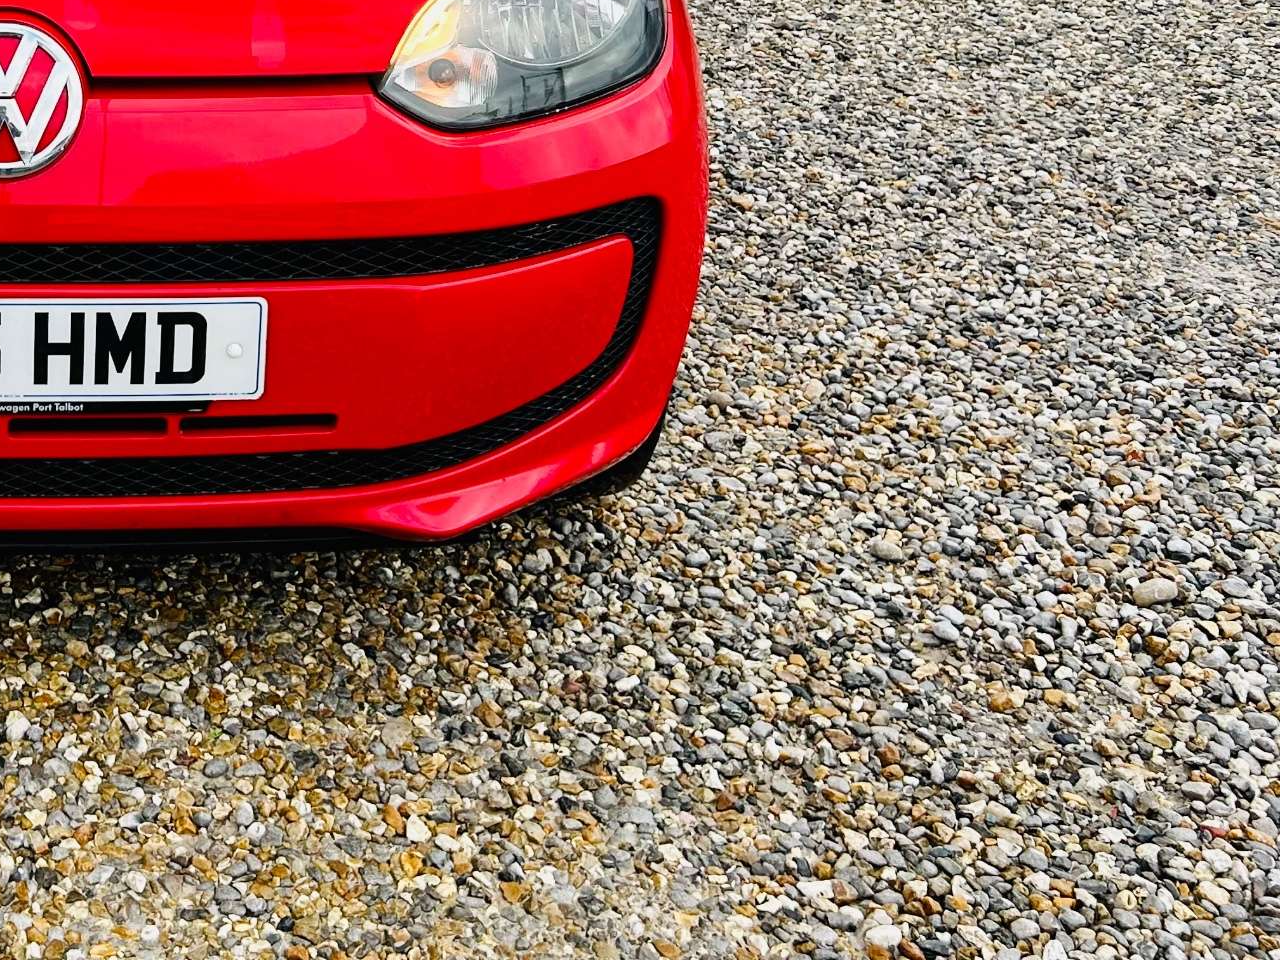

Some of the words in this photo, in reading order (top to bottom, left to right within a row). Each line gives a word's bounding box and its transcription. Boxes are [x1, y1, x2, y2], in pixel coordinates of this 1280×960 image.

[33, 311, 208, 385] HMD
[32, 402, 52, 412] Port
[54, 402, 84, 412] Talbot
